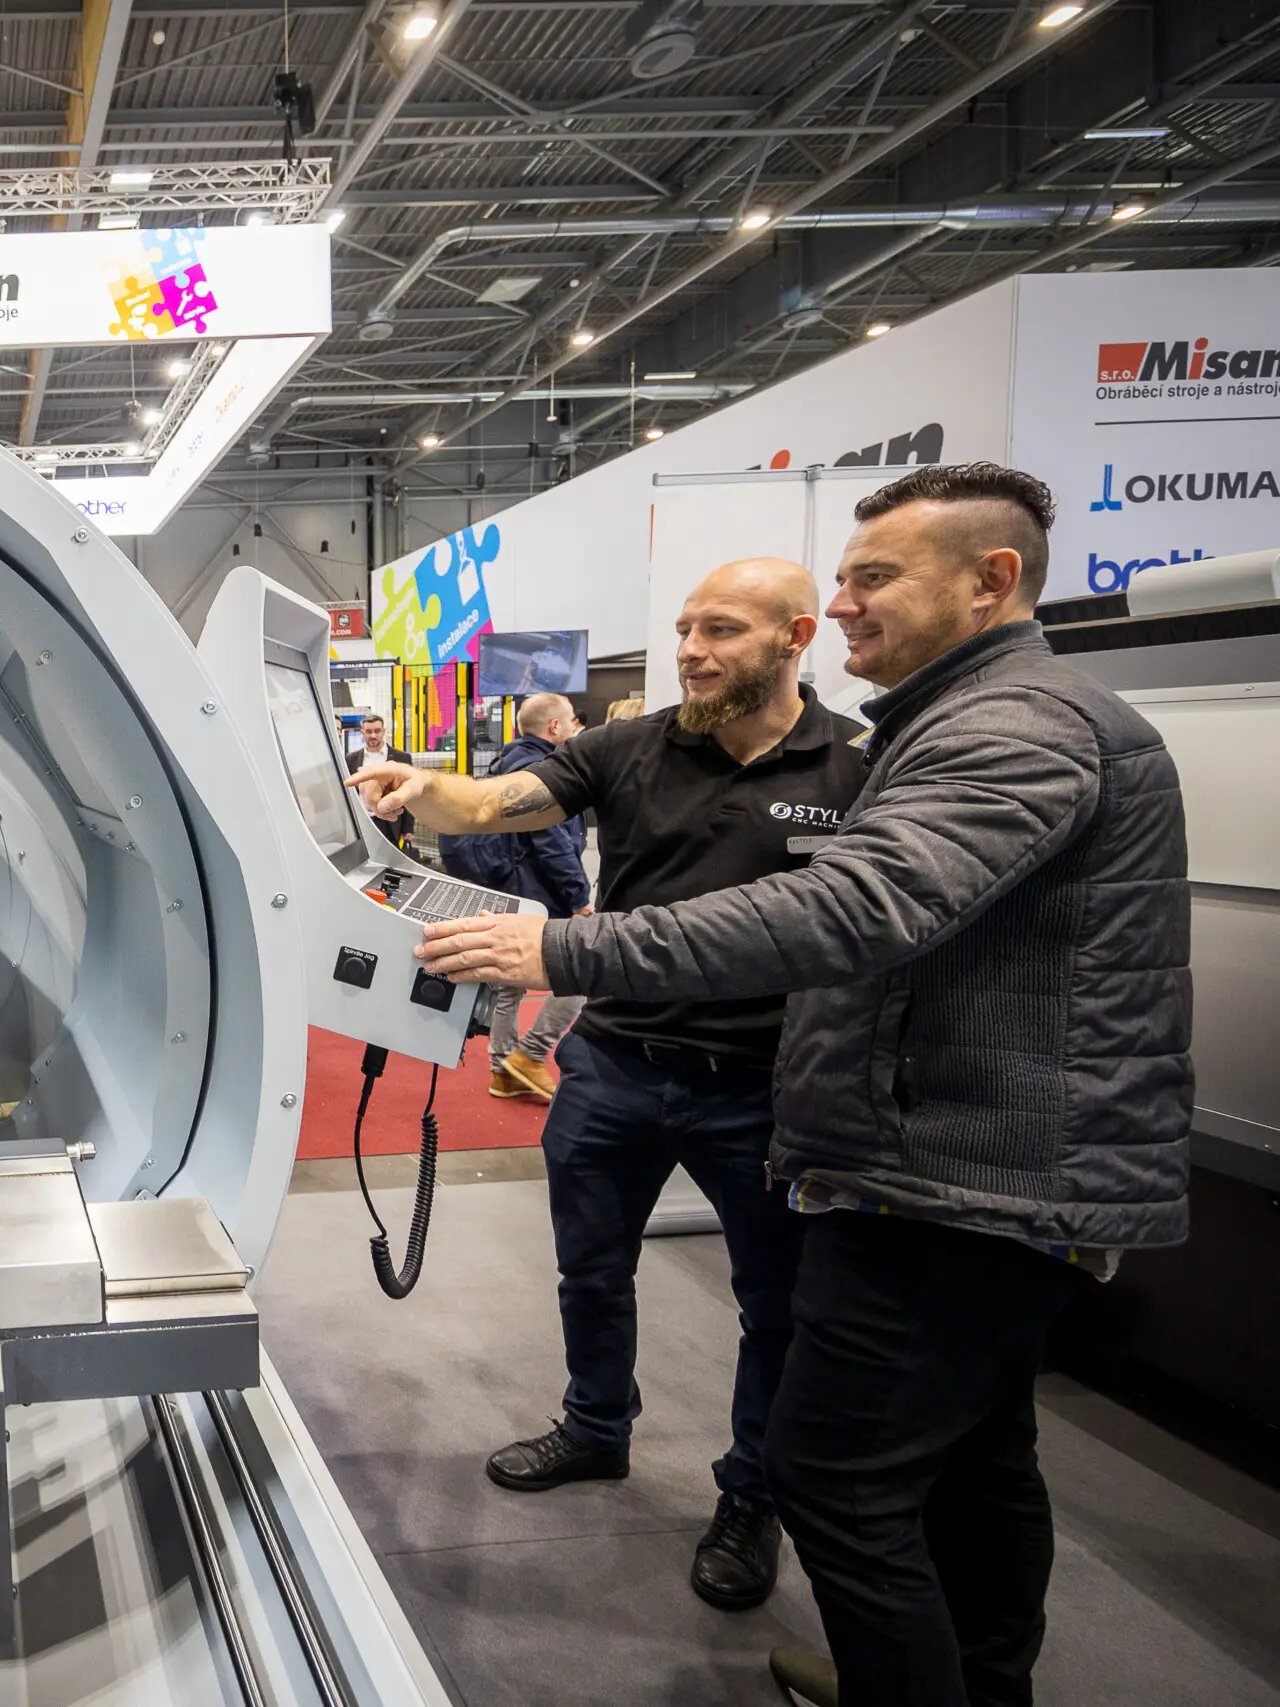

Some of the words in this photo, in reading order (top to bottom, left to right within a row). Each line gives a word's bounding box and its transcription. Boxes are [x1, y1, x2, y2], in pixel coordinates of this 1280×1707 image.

[1099, 370, 1135, 381] s.r.o.
[1138, 337, 1280, 382] Misan
[1095, 384, 1163, 400] Obráběcí
[1167, 383, 1209, 400] stroje
[1214, 385, 1222, 396] a
[1124, 470, 1280, 503] OKUMA
[792, 817, 808, 825] CNC
[793, 804, 842, 824] STYL
